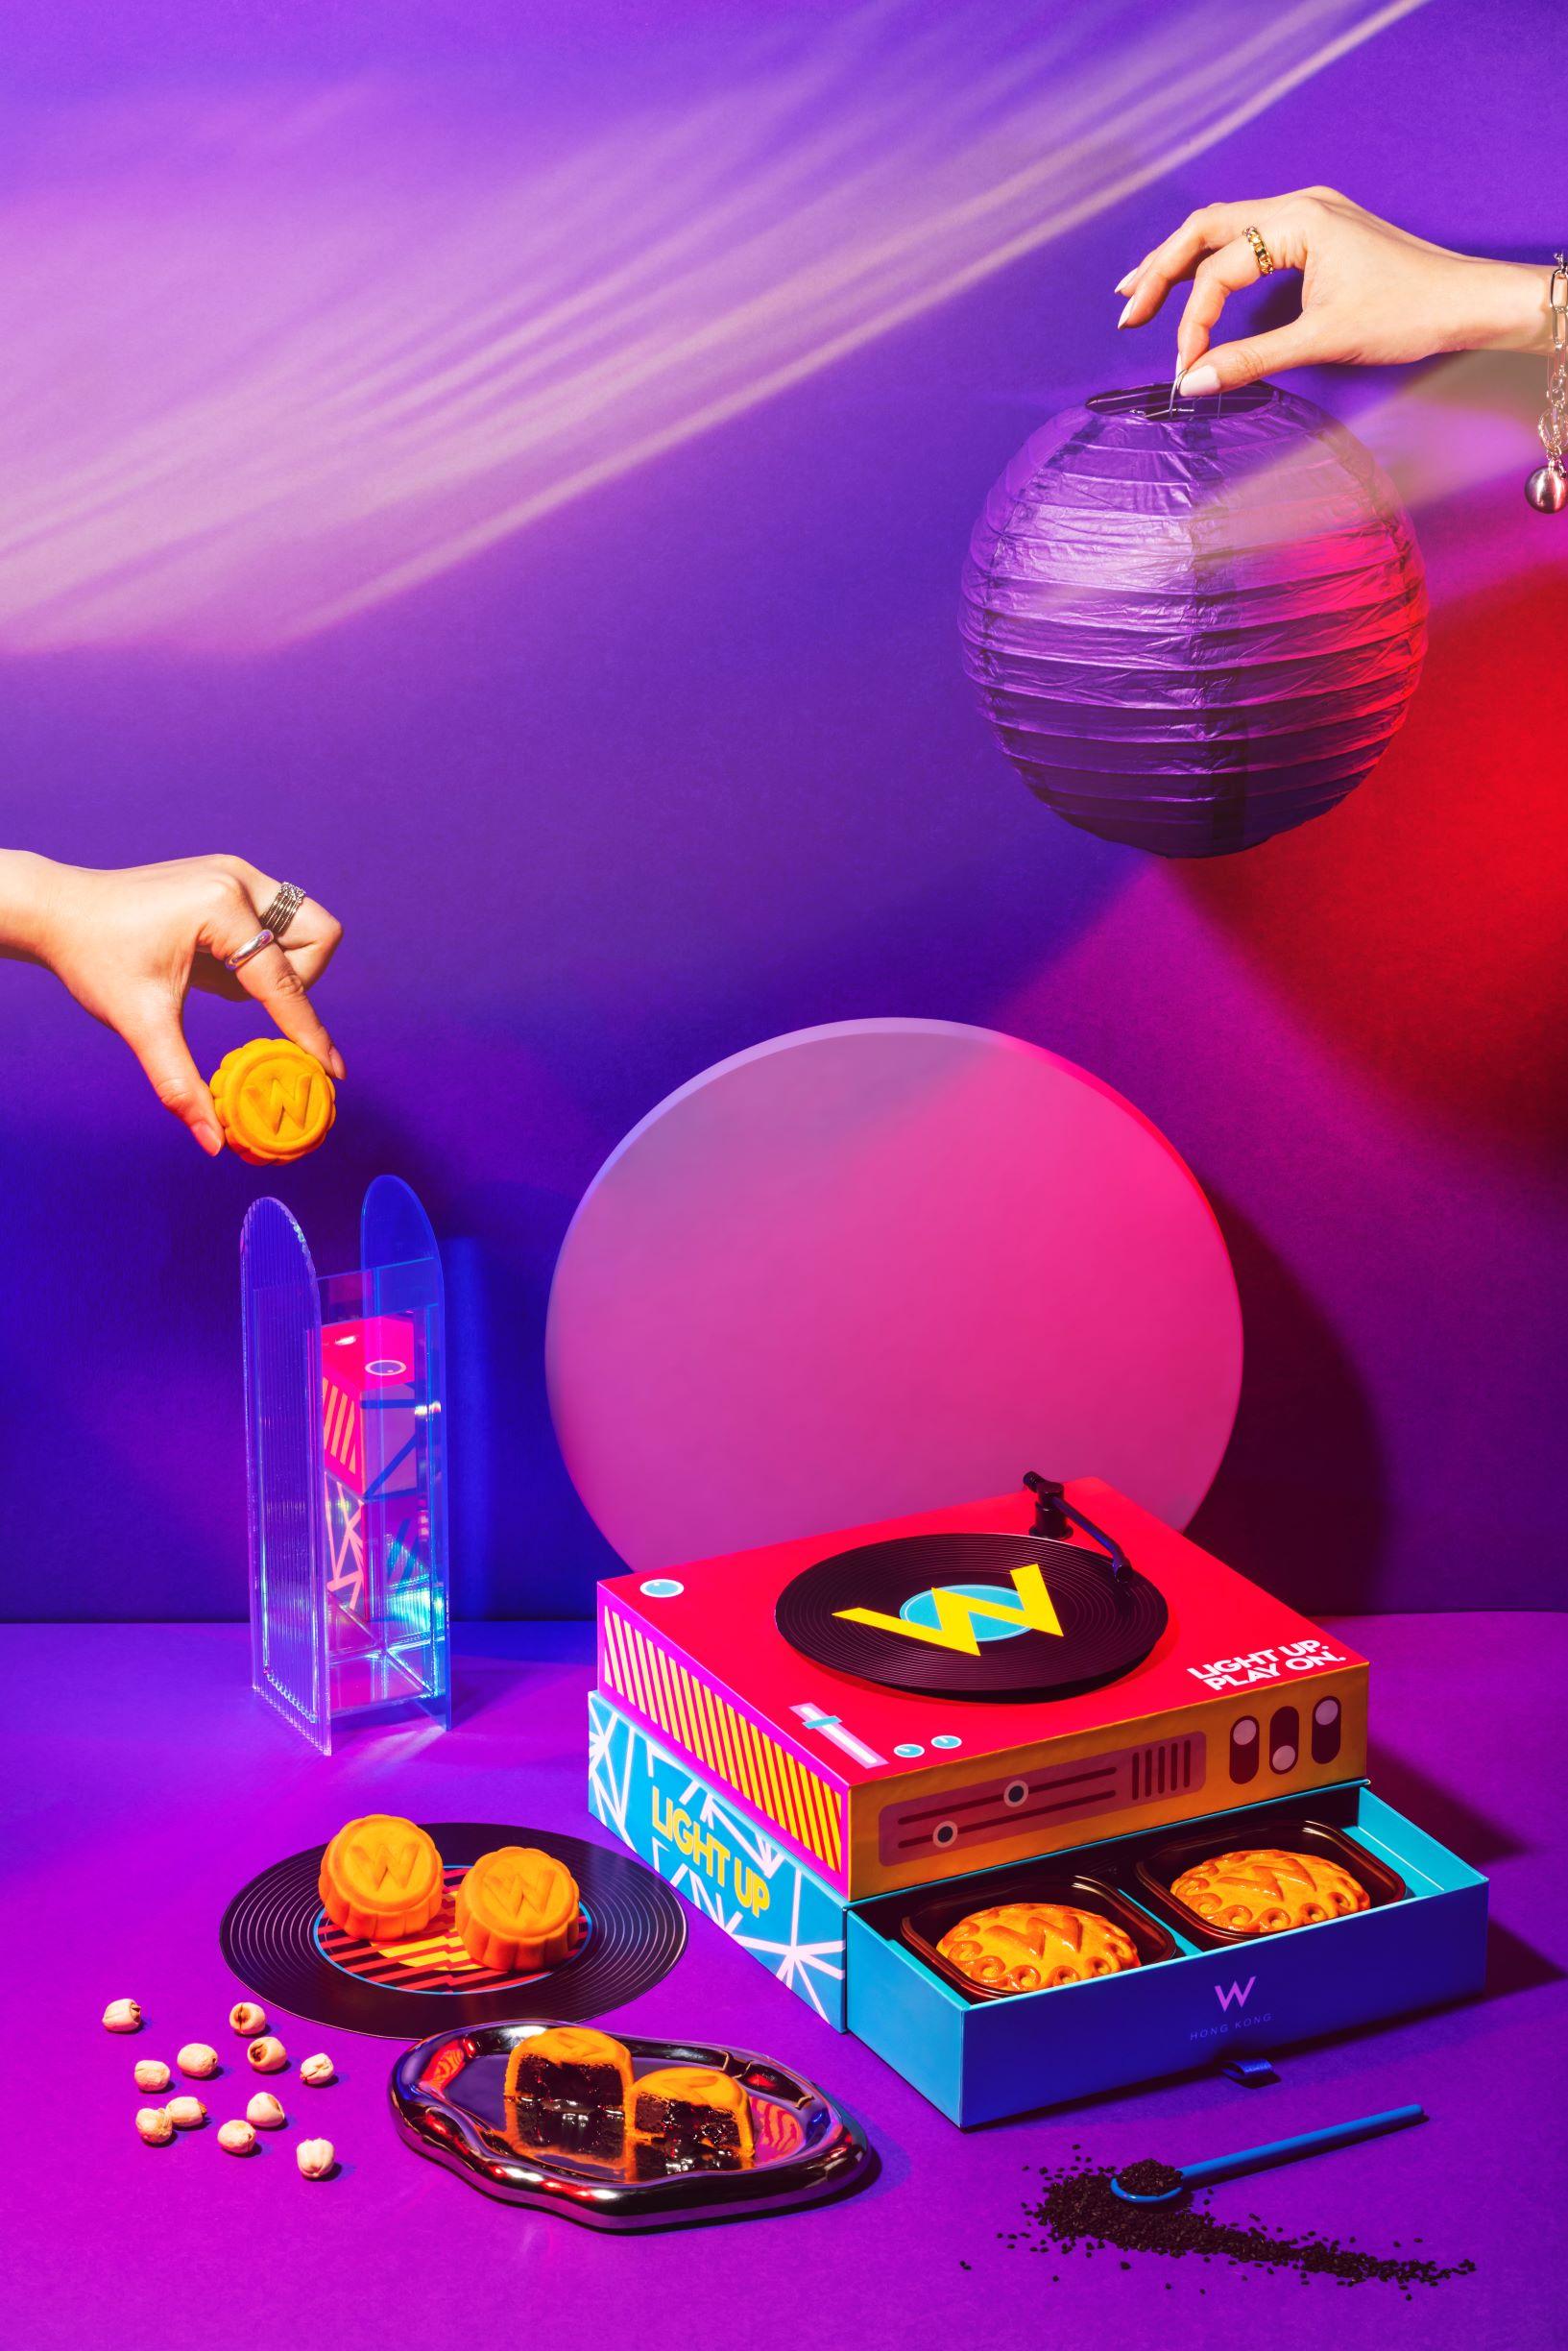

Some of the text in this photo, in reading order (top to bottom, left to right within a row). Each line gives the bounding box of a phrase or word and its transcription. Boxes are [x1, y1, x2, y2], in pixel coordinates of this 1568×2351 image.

[244, 1074, 312, 1135] W
[832, 1563, 1064, 1656] W
[1187, 1639, 1330, 1680] LIGHT UP.
[1203, 1651, 1346, 1690] PLAY ON.
[351, 1842, 421, 1890] W
[652, 1785, 770, 1918] LIGHT UP
[483, 1869, 557, 1917] W
[1218, 1857, 1317, 1902] W
[984, 1916, 1083, 1959] W
[1214, 1975, 1257, 2012] W
[1190, 2013, 1272, 2041] HONG KONG
